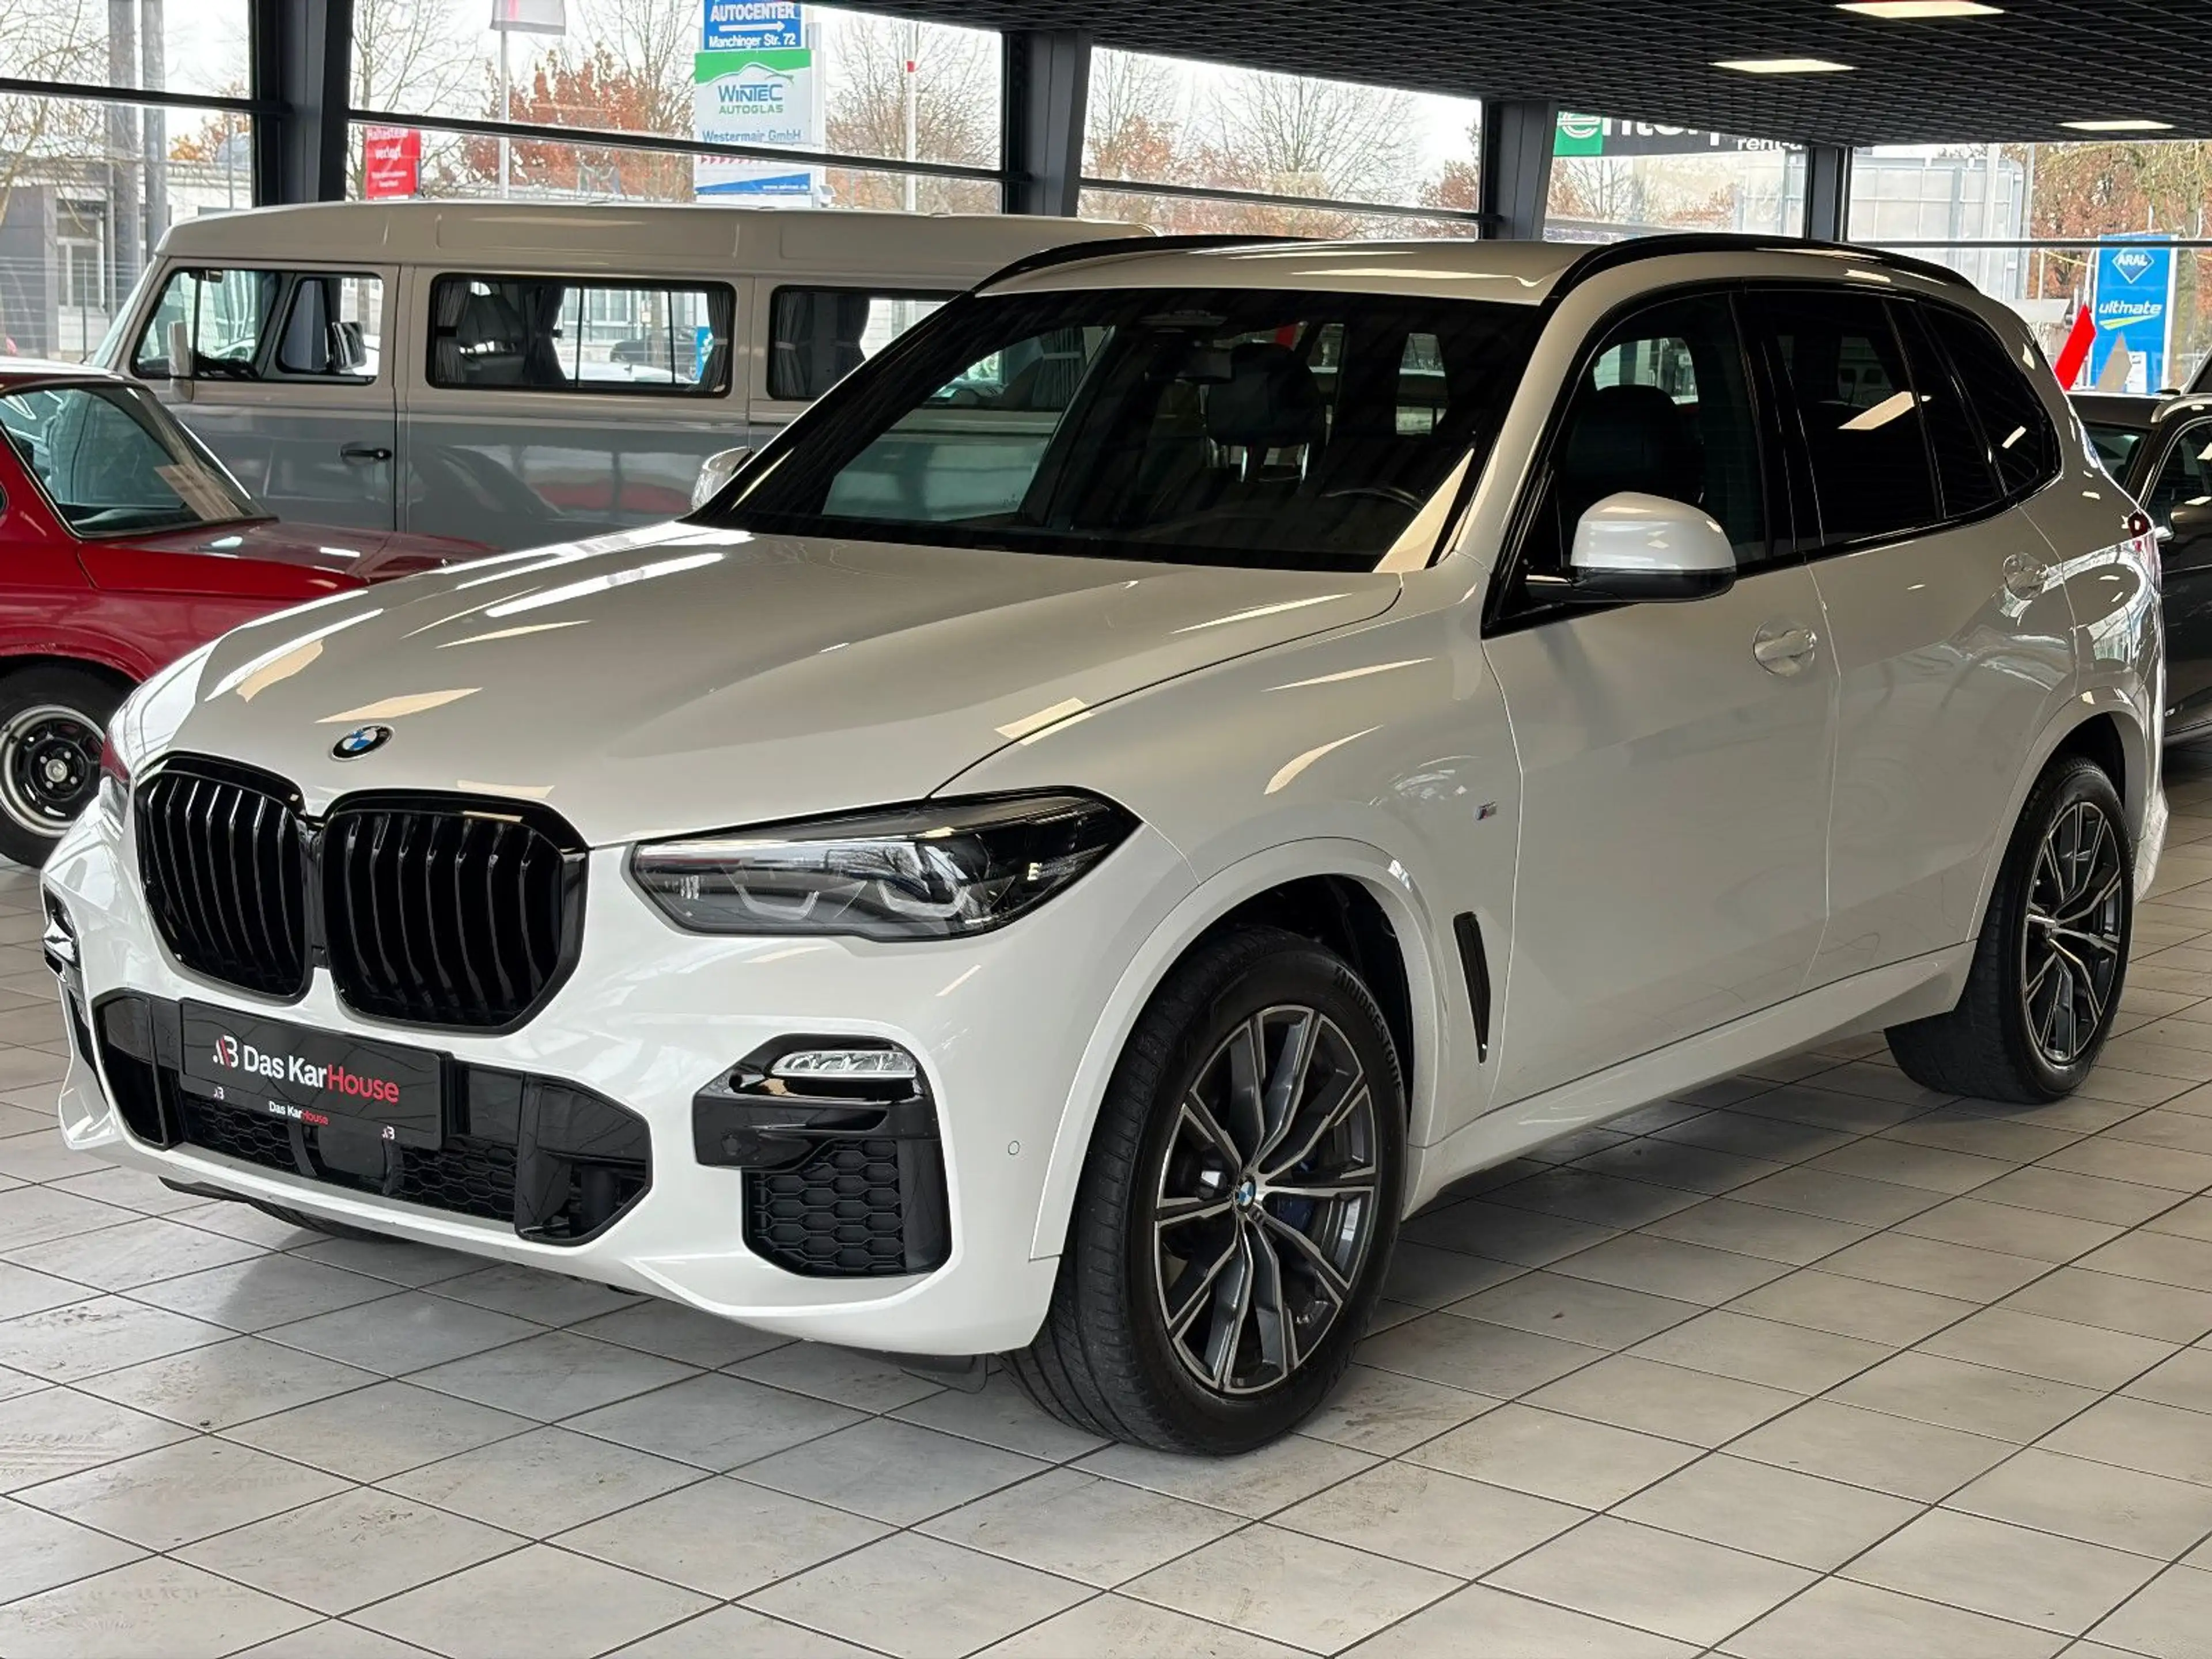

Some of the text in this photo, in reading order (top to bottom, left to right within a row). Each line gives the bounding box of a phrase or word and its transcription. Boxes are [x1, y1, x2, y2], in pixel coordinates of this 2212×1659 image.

[710, 2, 795, 21] AUTOCENTER
[709, 33, 796, 48] Manchinger Str. 72
[719, 104, 783, 115] AUTOGLAS
[702, 130, 801, 142] Westermair GmbH
[2118, 255, 2148, 266] ARAL
[2099, 300, 2163, 315] ultimate
[243, 1045, 399, 1104] Das KarHouse
[268, 1100, 329, 1125] Das KarHouse
